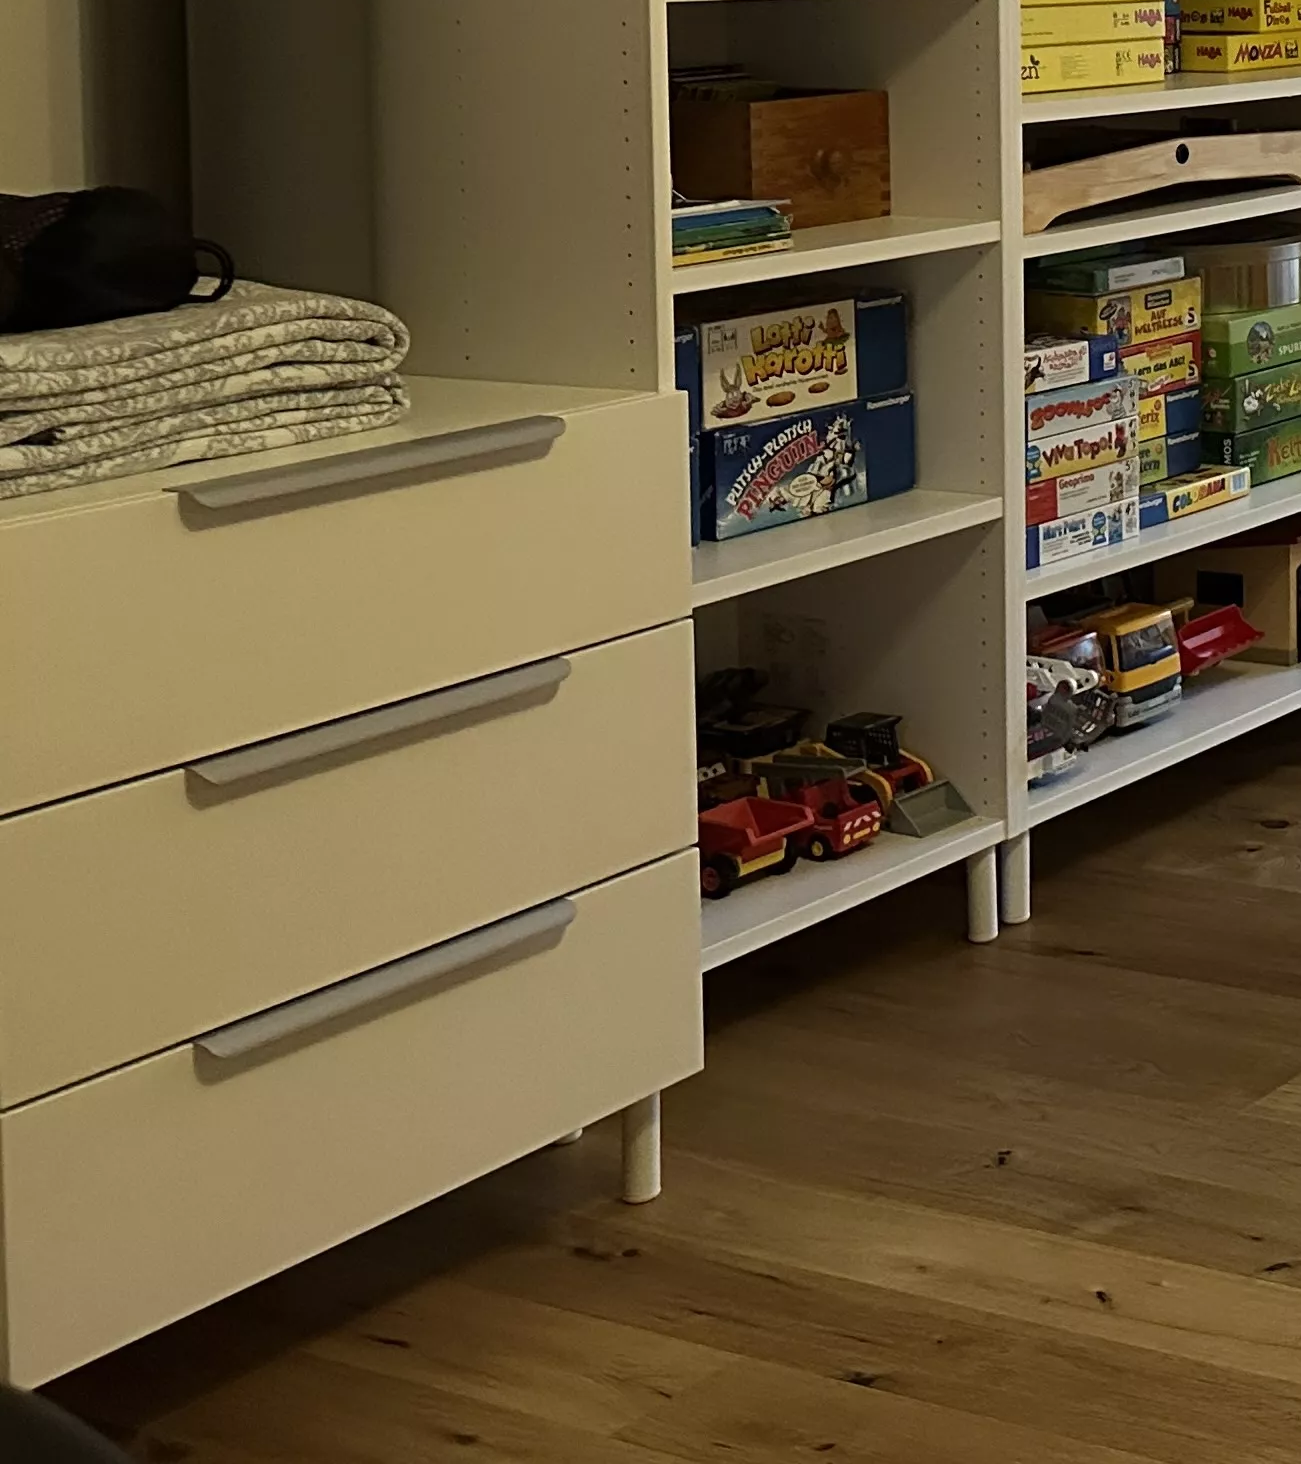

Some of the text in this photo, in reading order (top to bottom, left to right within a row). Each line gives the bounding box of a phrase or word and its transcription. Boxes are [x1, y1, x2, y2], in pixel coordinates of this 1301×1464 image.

[1134, 9, 1163, 27] HABA
[1228, 6, 1254, 21] HABA
[1137, 52, 1162, 69] HABA
[1196, 45, 1223, 60] HABA
[1233, 40, 1283, 65] MONZA
[751, 315, 816, 356] Lotti
[741, 342, 849, 387] Karotti
[1074, 432, 1113, 461] Topo!
[1223, 438, 1232, 466] MOS
[735, 430, 826, 522] PINGUIN
[1172, 477, 1227, 514] COLORAMA
